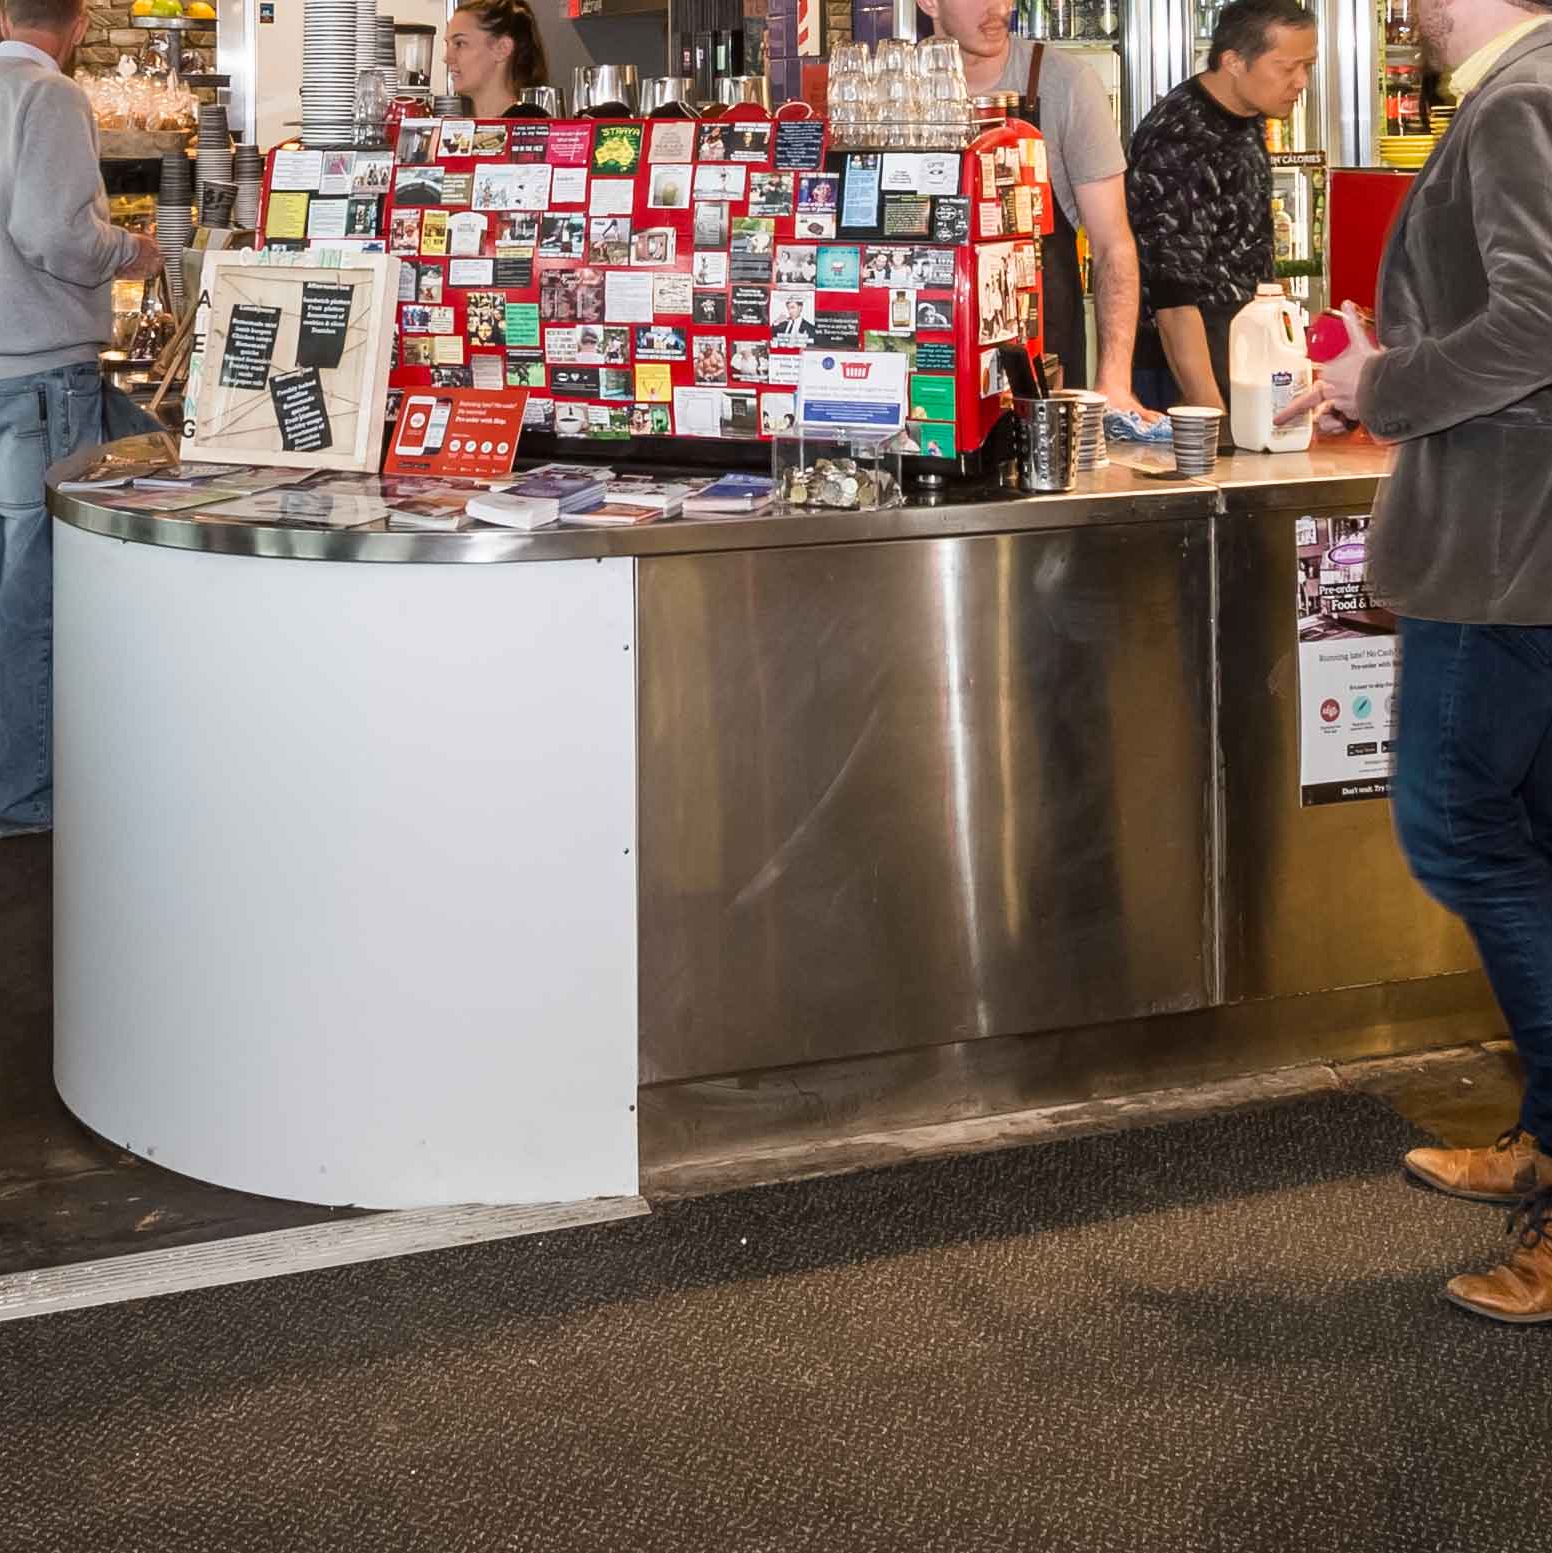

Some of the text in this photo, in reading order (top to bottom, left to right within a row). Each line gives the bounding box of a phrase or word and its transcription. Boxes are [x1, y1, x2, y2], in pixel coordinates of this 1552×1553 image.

[602, 126, 640, 137] STRAYA
[1319, 583, 1360, 597] Pre-order
[1331, 598, 1357, 611] Food
[1358, 598, 1367, 609] &
